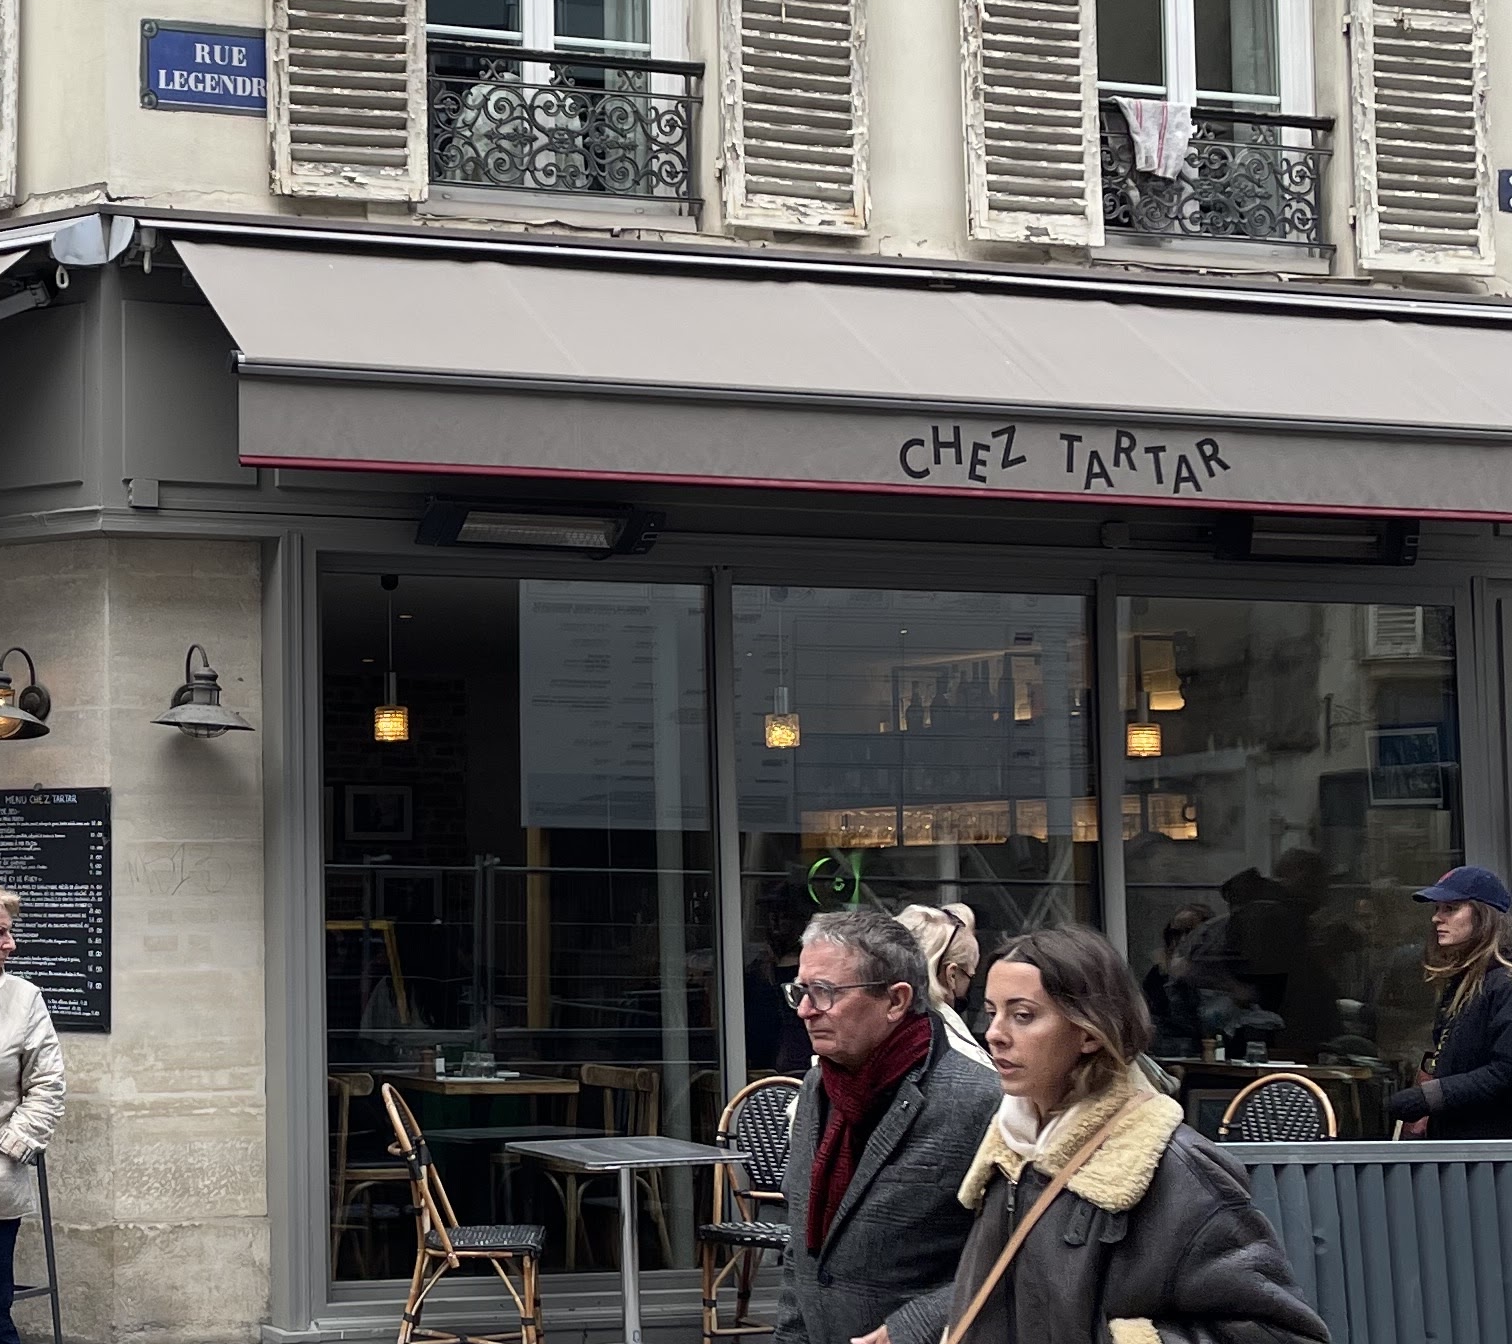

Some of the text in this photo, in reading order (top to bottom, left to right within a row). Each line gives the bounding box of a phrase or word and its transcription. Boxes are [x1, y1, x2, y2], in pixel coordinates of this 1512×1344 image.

[194, 43, 247, 67] RUE
[158, 69, 267, 98] LEGENDR
[899, 425, 1231, 494] CHEZ TARTAR
[28, 794, 51, 804] CHEZ
[53, 794, 78, 804] TARTAR
